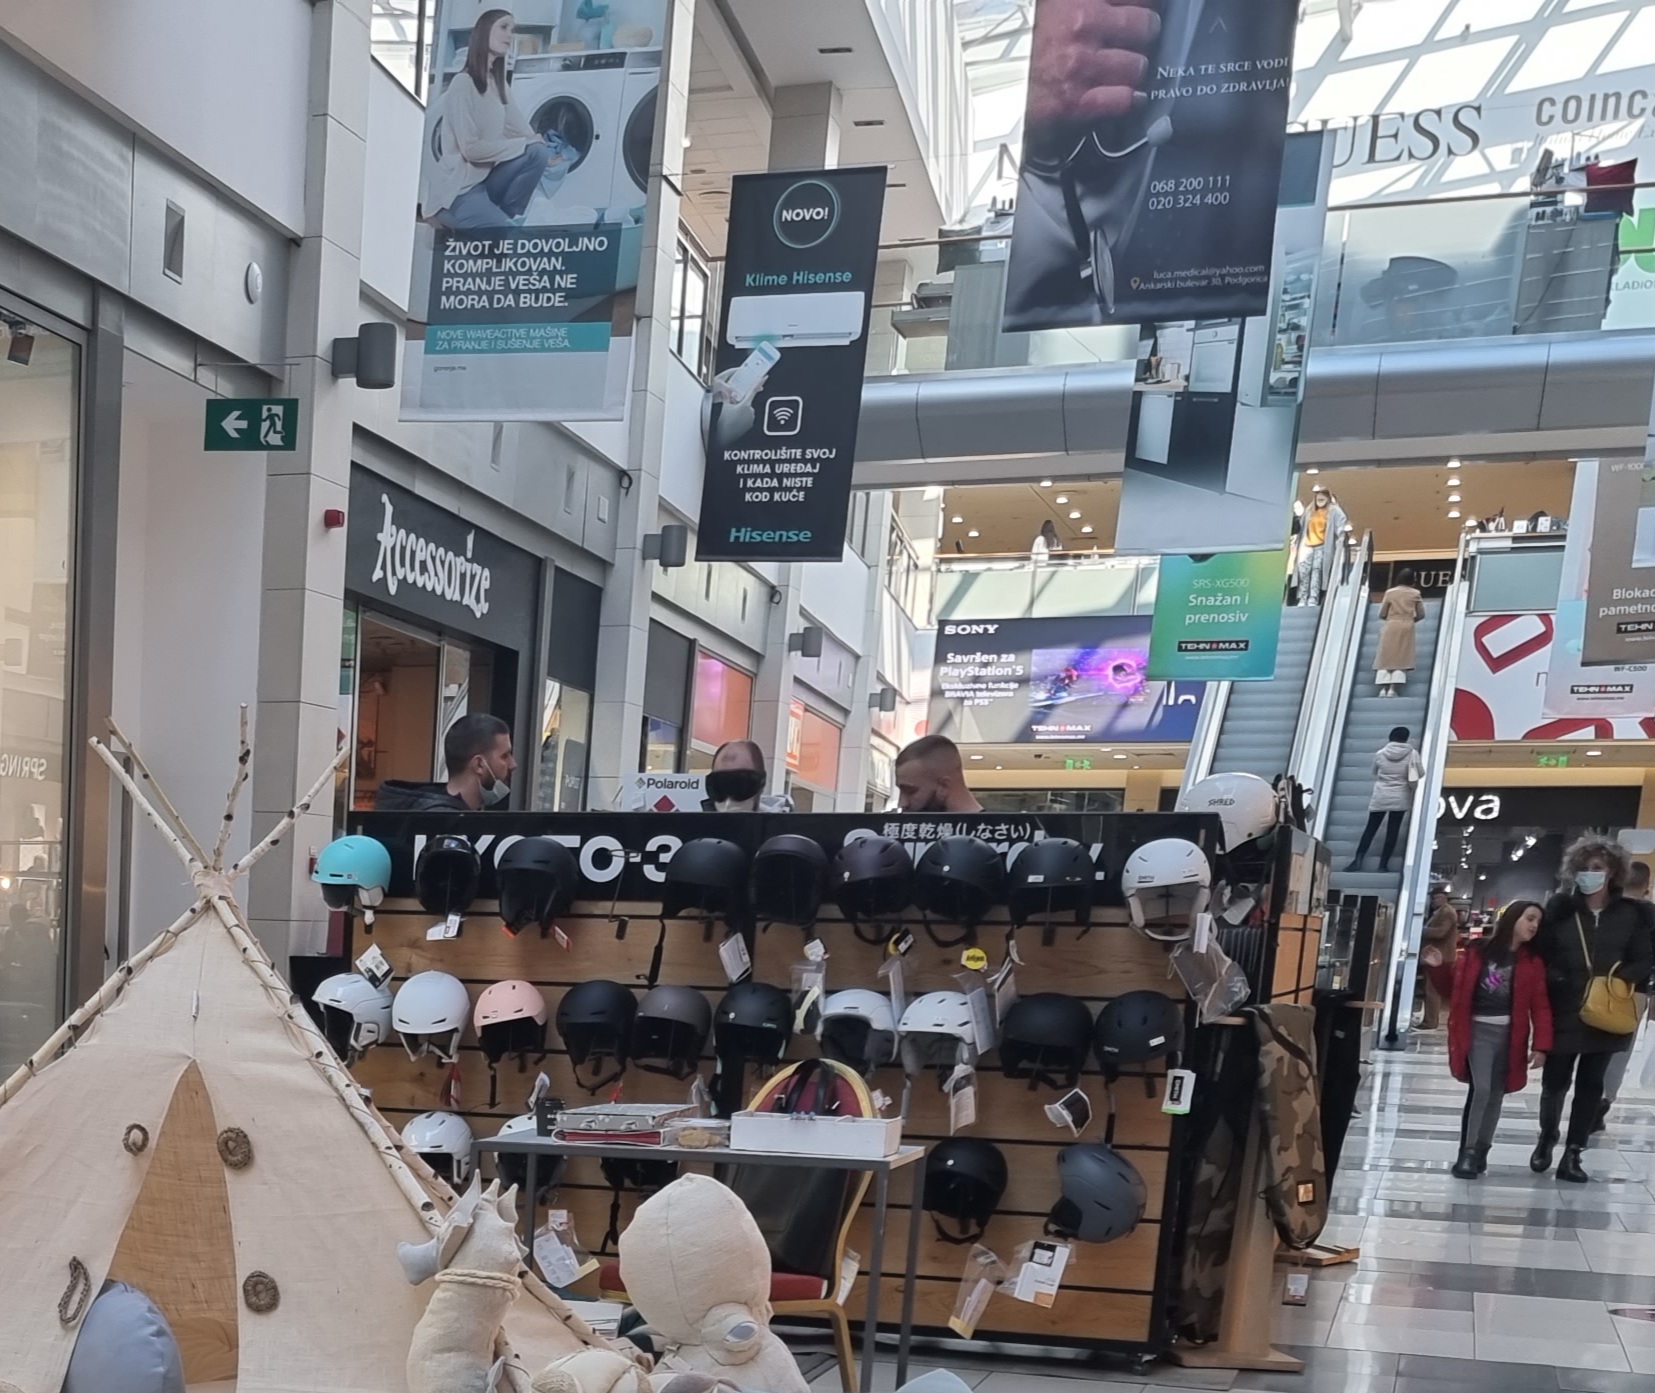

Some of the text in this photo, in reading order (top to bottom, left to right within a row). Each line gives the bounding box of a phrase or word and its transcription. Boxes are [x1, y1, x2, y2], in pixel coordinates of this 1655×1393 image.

[1199, 64, 1216, 75] TE
[1218, 61, 1252, 73] SRCE
[1255, 57, 1288, 70] VODI
[1150, 86, 1193, 100] PRAVO
[1196, 84, 1217, 95] DO
[1535, 89, 1655, 127] coinc
[1286, 103, 1482, 168] UESS
[1150, 175, 1230, 193] 068 200 111
[1148, 192, 1230, 210] 020 324 400
[781, 207, 829, 222] NOVO!
[445, 237, 608, 255] ŽIVOT JE DOVOLJNO
[444, 256, 565, 274] KOMPLIKOVAN.
[442, 272, 577, 291] PRANJE VEŠA NE
[745, 271, 852, 287] Klime Hisense
[1611, 279, 1655, 292] LADIO
[440, 293, 568, 309] MORA DA BUDE.
[437, 326, 568, 340] NOVE WAVEACTIVE MAŠINE
[435, 341, 449, 350] ZA
[451, 339, 489, 350] PRANJE
[497, 336, 542, 349] SUŠENJE
[723, 447, 836, 461] KONTROLIŠITE SVOJ
[736, 464, 771, 474] KLIMA
[739, 477, 814, 488] I KADA NISTE
[744, 491, 770, 502] KOD
[729, 527, 812, 543] Hisense
[372, 493, 490, 618] Accessorize
[1188, 592, 1250, 606] Snažan i
[1185, 610, 1249, 626] prenosiv
[944, 624, 999, 635] SONY
[946, 653, 1016, 663] Savršen za
[647, 777, 700, 790] Polaroid
